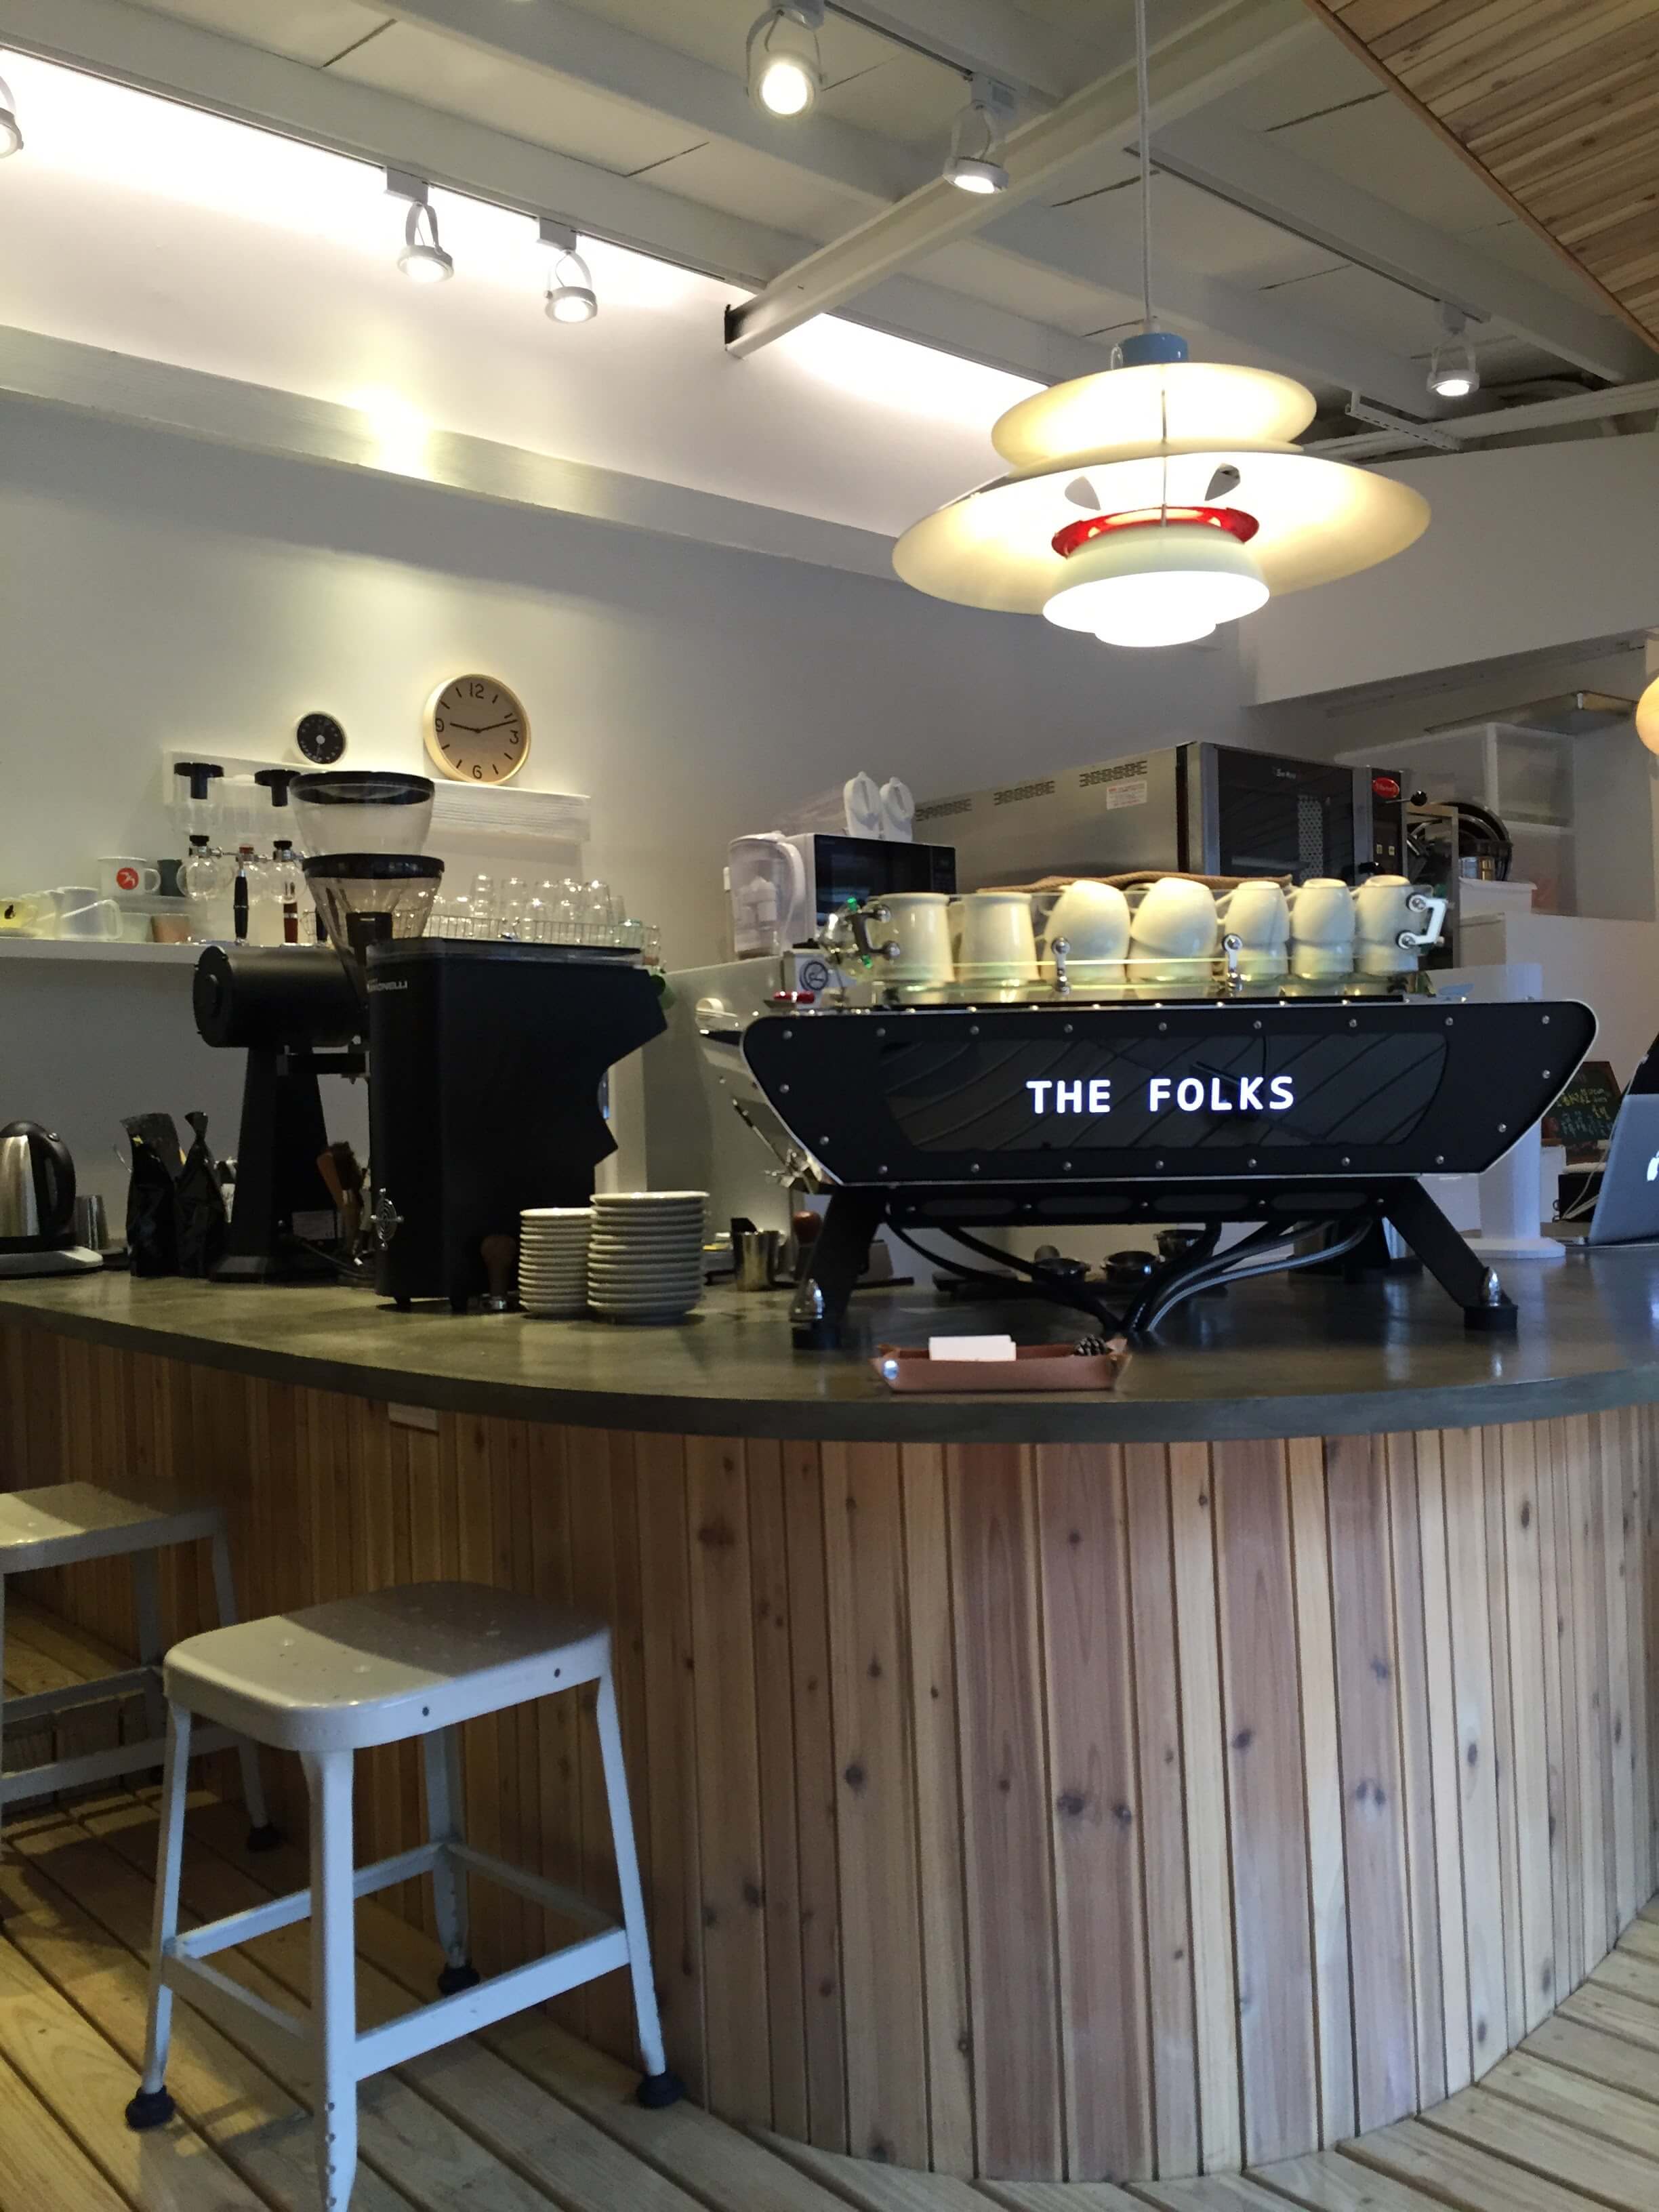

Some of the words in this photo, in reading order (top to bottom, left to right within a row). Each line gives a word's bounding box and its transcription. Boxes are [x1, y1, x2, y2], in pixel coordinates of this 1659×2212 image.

[470, 682, 484, 699] 12
[435, 718, 445, 732] 9
[510, 730, 518, 744] 3
[472, 765, 483, 779] 6
[1026, 1079, 1111, 1113] THE
[1149, 1076, 1294, 1112] FOLKS
